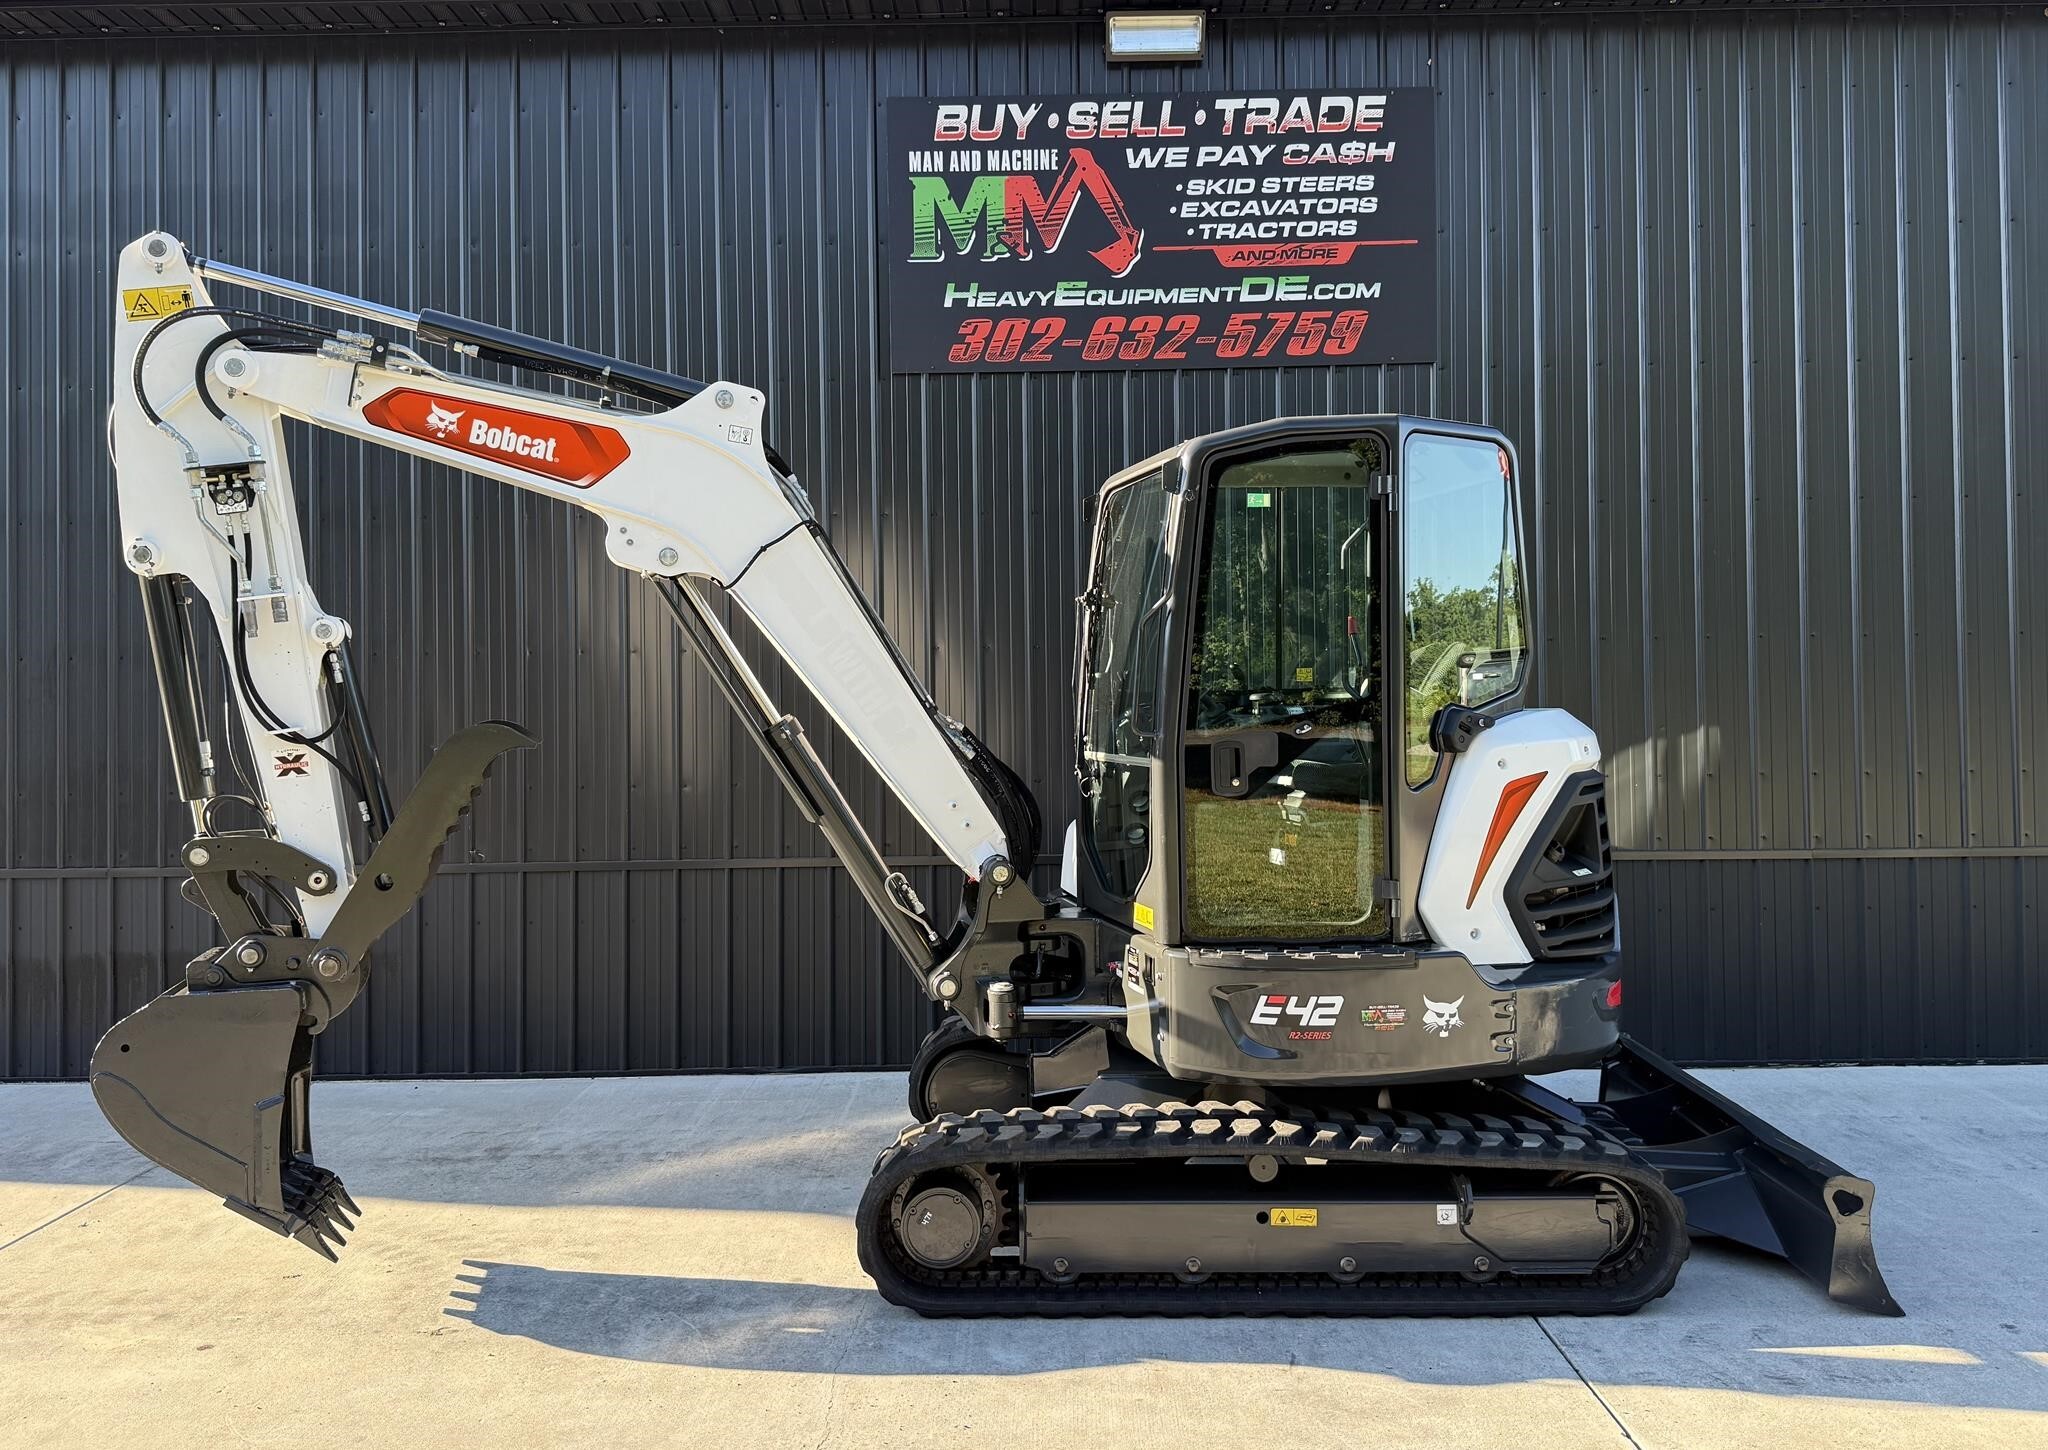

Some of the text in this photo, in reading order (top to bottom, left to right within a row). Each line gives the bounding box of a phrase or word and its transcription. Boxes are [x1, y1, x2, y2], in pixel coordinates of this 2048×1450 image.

[934, 95, 1387, 142] BUY SELL TRADE
[908, 149, 1058, 172] MAN AND MACHINE
[1125, 146, 1190, 169] WE
[1196, 144, 1277, 167] PAY
[1186, 175, 1375, 196] SKID STEERS
[1180, 197, 1379, 218] EXCAVATORS
[1199, 220, 1358, 240] TRACTORS
[948, 310, 1369, 363] 302-632-5759
[468, 418, 557, 463] Bobcat
[1249, 995, 1345, 1026] E42
[1288, 1031, 1332, 1040] R2-SERIES
